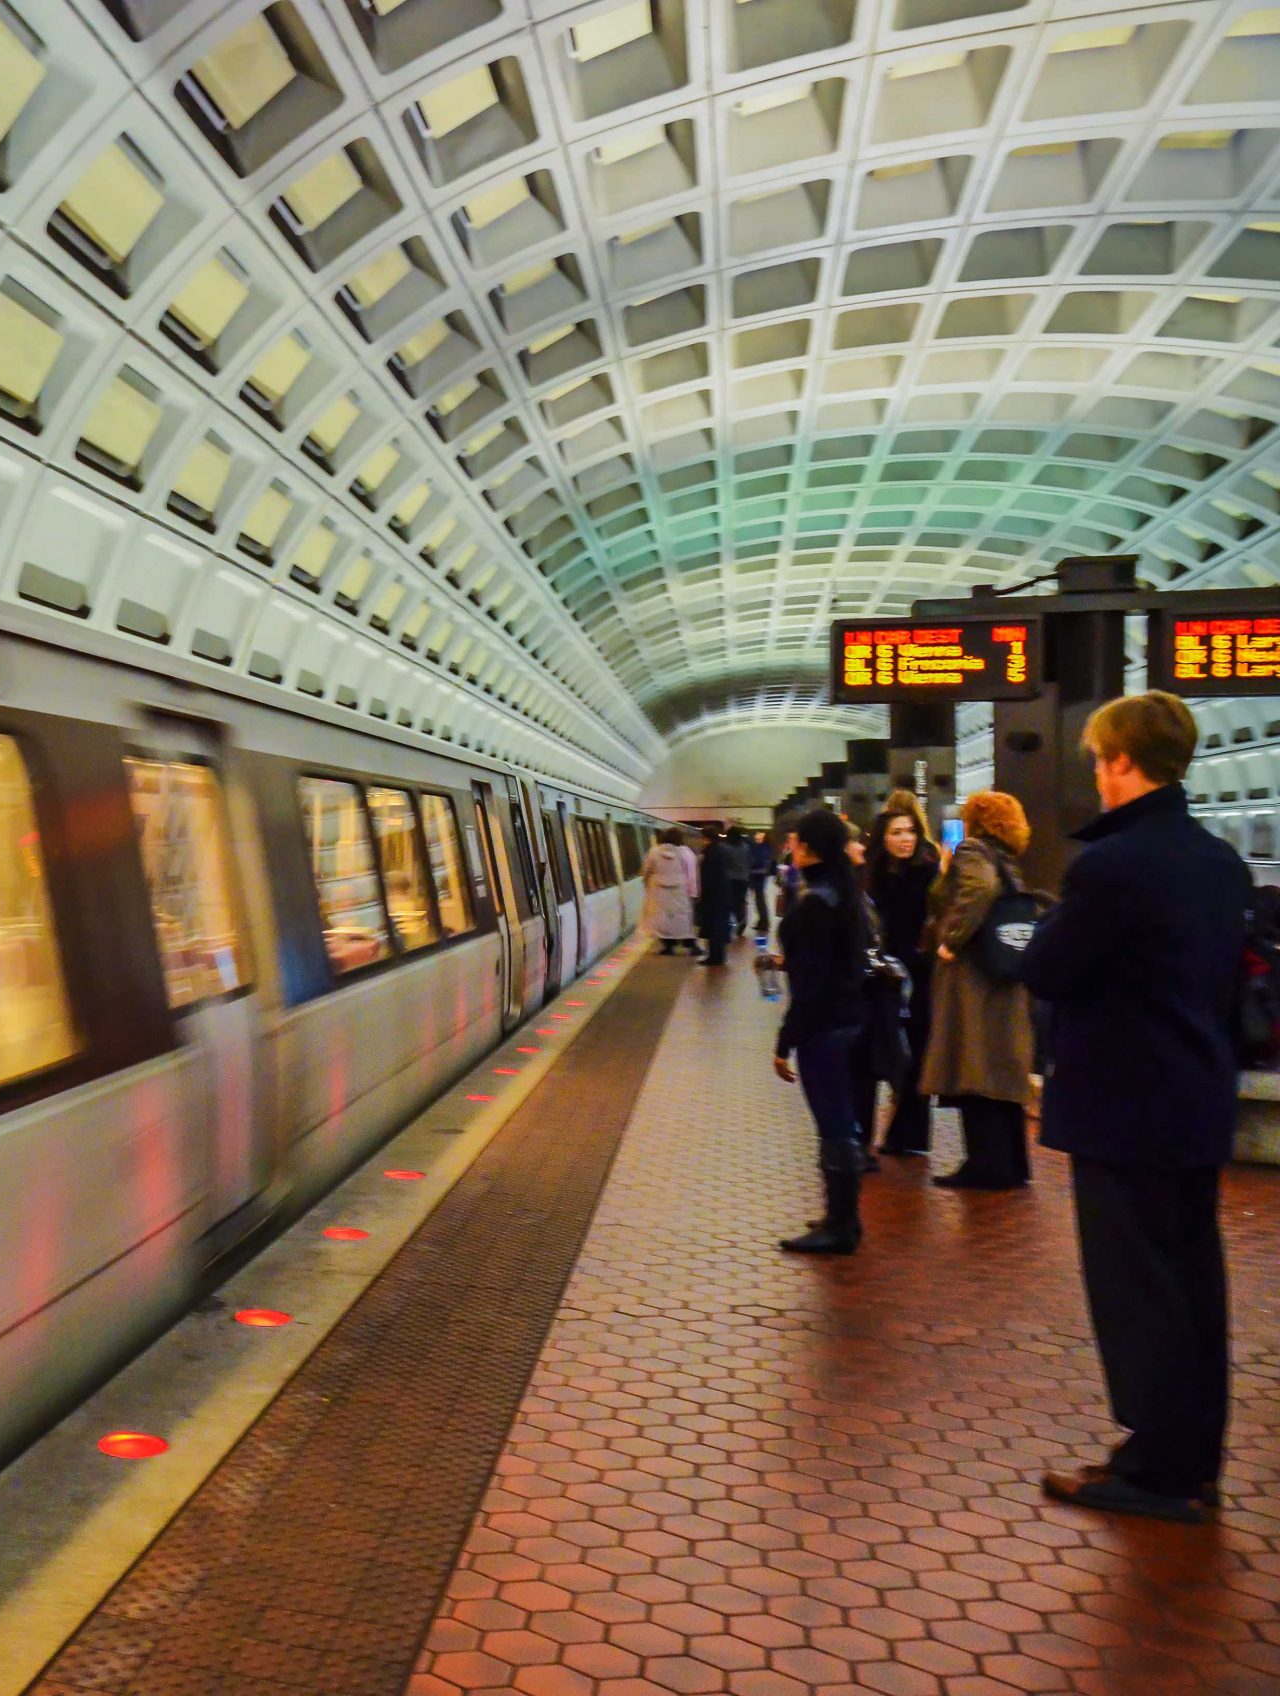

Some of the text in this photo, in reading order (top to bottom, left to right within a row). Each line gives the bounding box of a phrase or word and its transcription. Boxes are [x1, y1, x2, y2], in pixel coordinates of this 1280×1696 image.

[1211, 634, 1233, 648] 6
[876, 644, 894, 658] 6
[1010, 641, 1024, 655] 1
[1211, 648, 1233, 662] 6
[876, 657, 894, 671] 6
[1006, 654, 1026, 669] 3
[1211, 662, 1233, 677] 6
[876, 670, 894, 685] 6
[1006, 668, 1026, 683] 5
